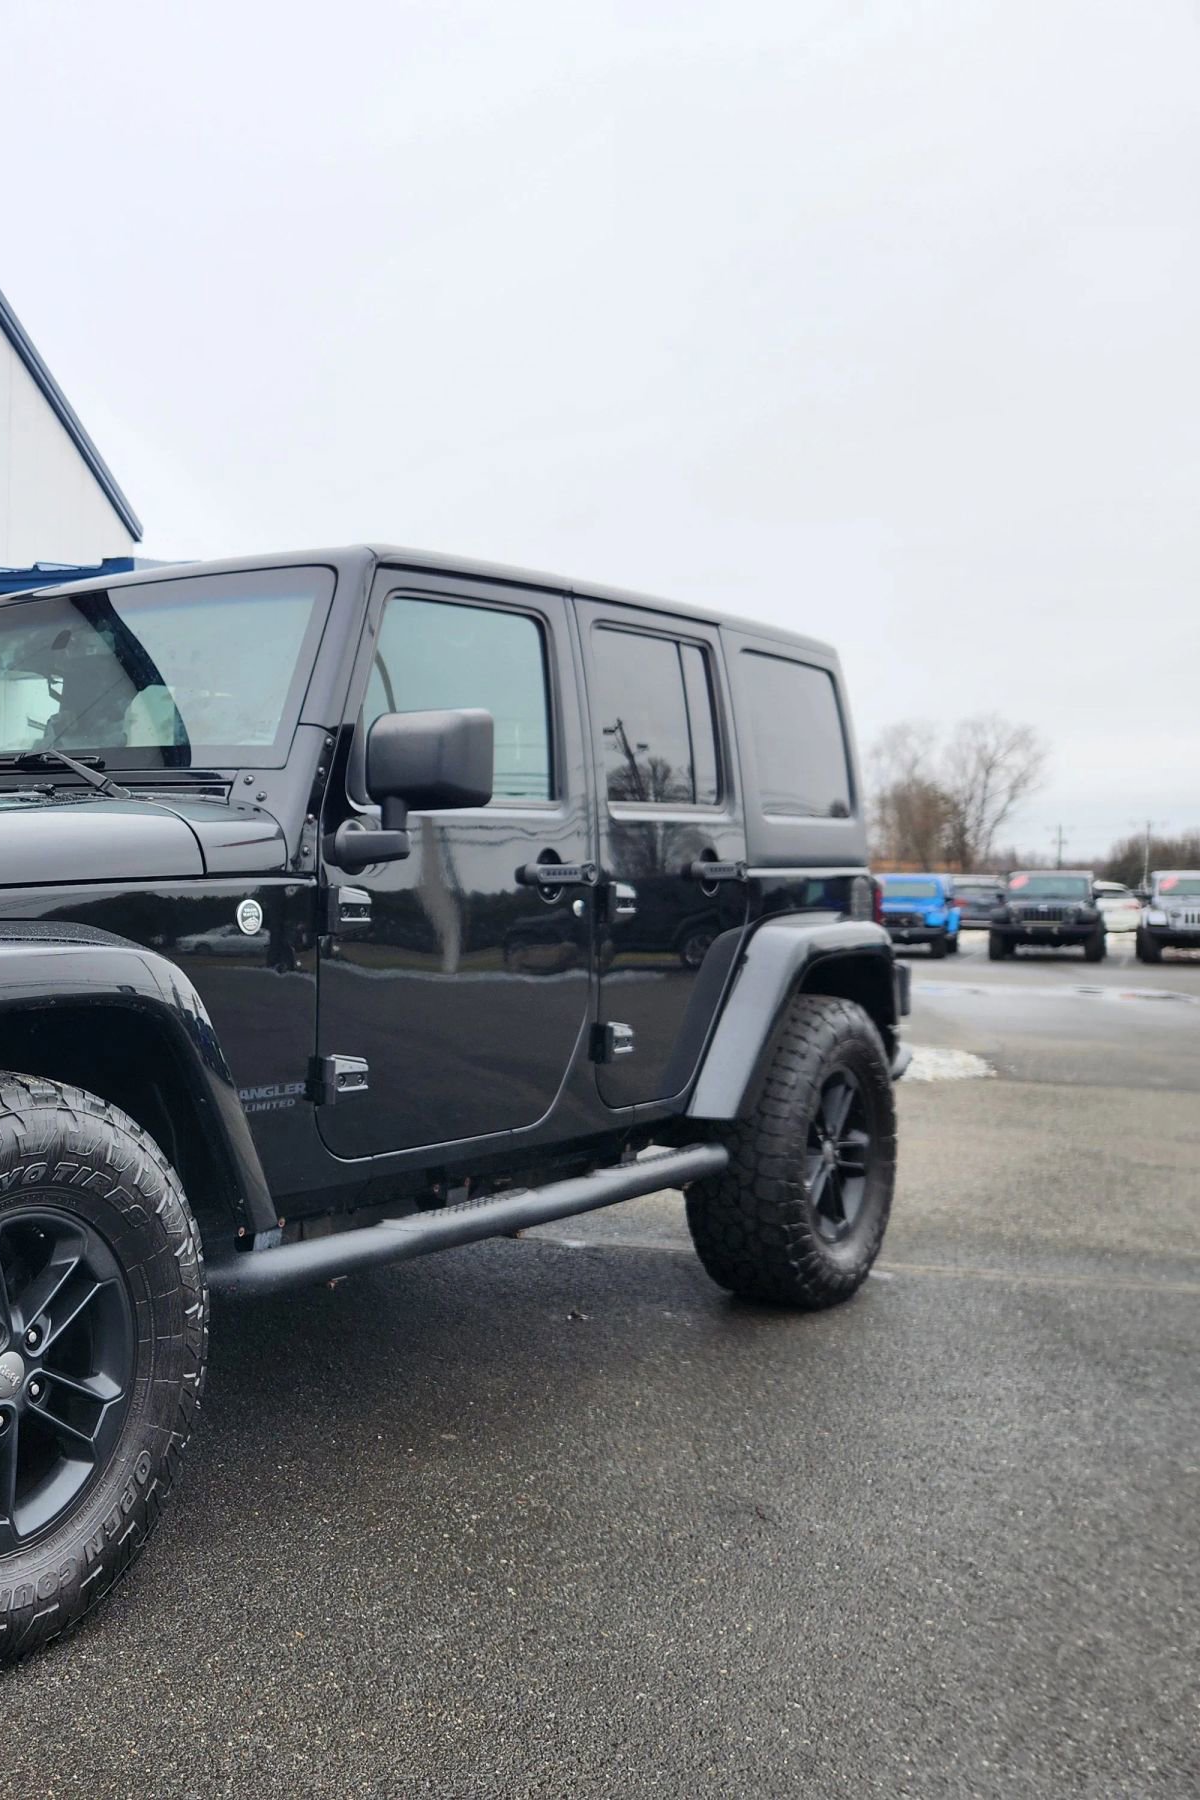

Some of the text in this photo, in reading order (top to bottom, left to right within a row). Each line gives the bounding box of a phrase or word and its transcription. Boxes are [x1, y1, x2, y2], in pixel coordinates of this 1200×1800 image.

[239, 1082, 307, 1101] ANGLER
[244, 1098, 296, 1113] LIMITED
[52, 1161, 151, 1229] TIRES
[83, 1450, 152, 1565] OPEN
